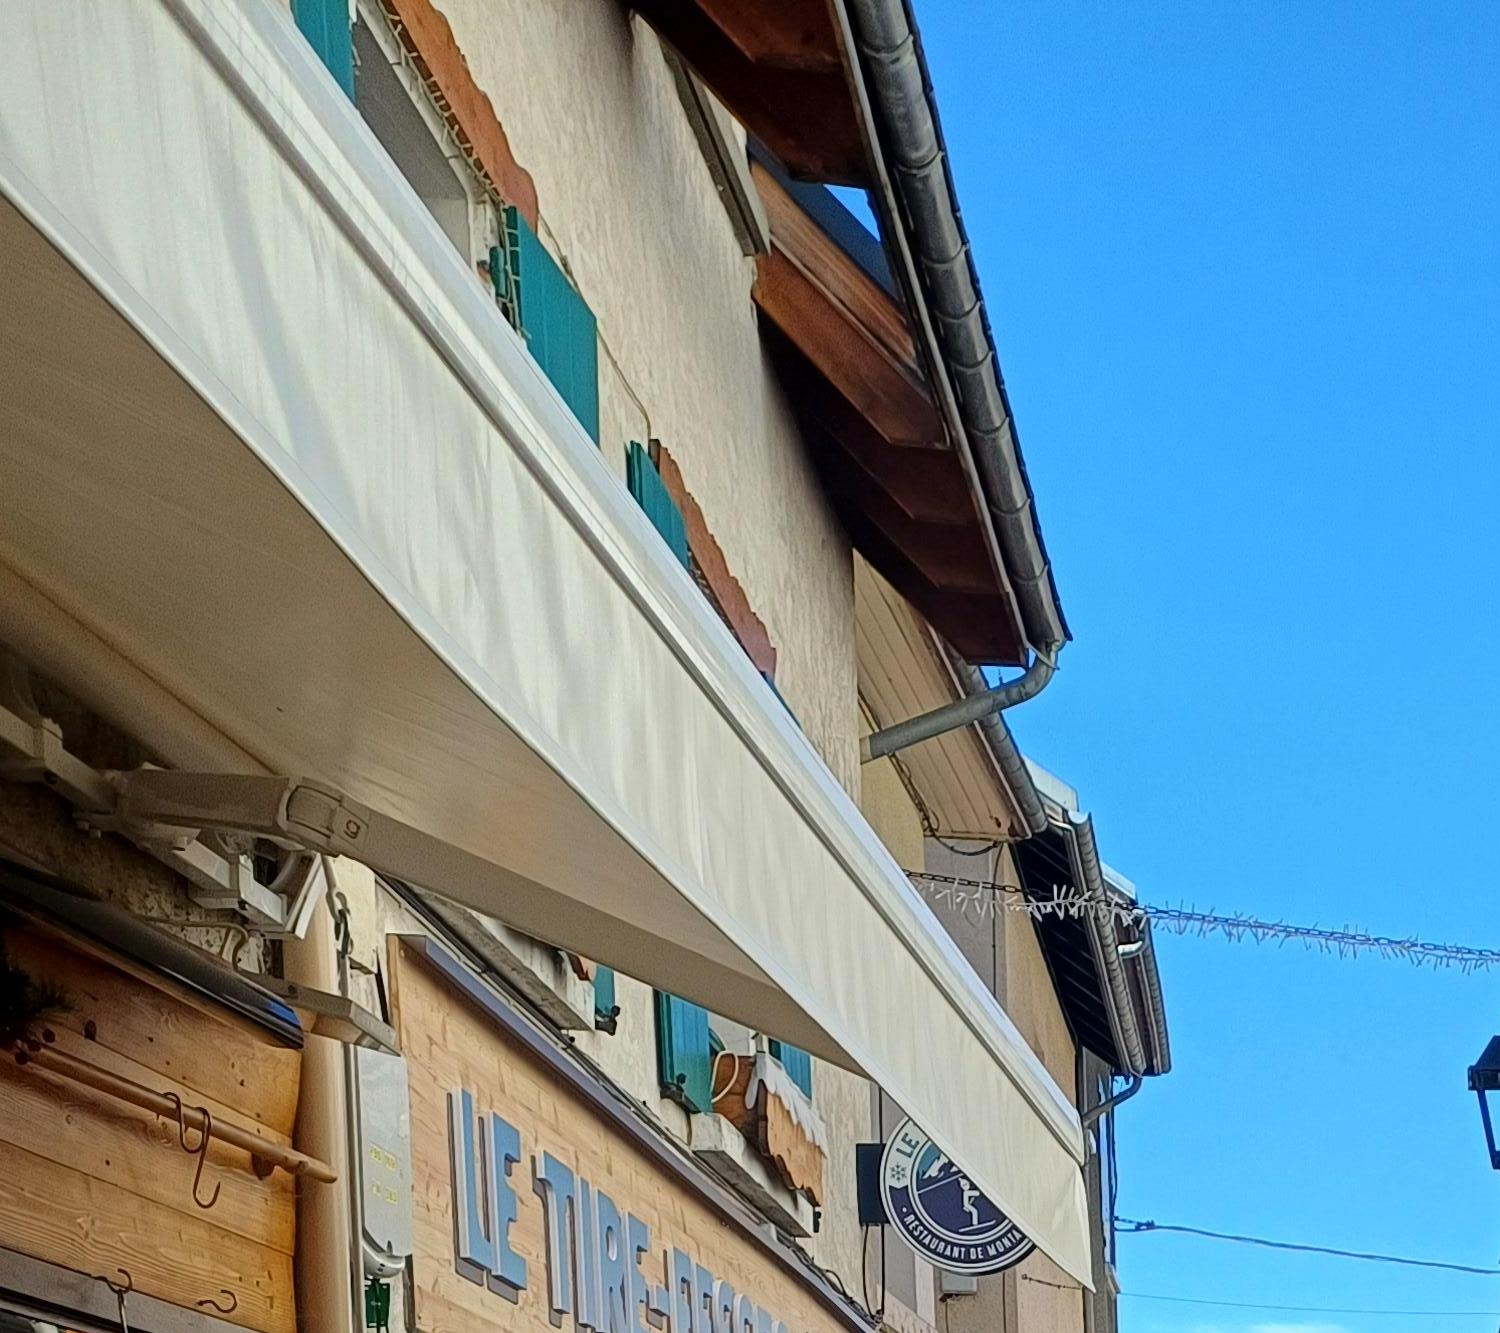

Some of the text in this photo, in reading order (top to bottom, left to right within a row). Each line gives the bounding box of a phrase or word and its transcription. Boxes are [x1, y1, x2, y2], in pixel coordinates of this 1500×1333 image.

[896, 1132, 920, 1158] LE
[450, 1086, 528, 1293] LE
[904, 1214, 1023, 1260] RESTAURANT DE MONTA
